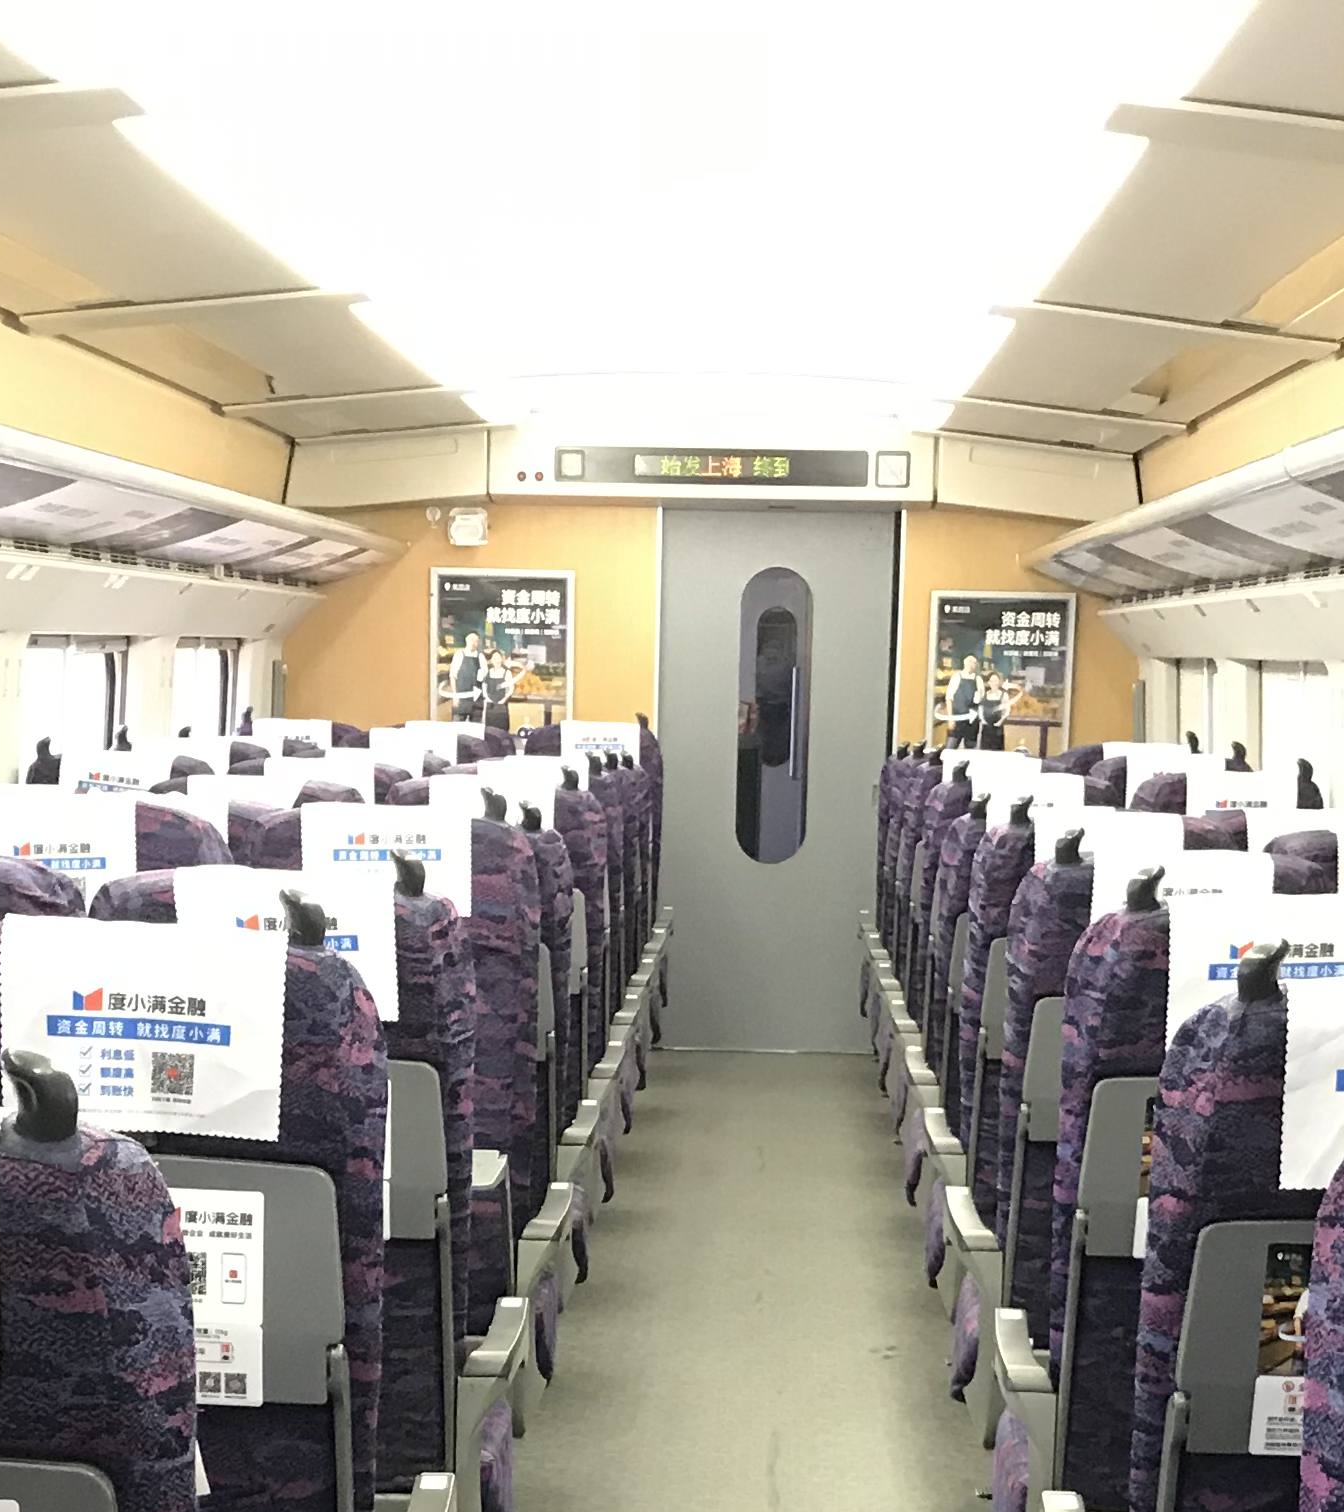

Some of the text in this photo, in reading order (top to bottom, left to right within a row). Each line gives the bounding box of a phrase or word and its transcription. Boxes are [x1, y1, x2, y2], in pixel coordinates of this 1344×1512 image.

[502, 589, 561, 606] 资金周转
[486, 606, 561, 625] 就找度小满
[1001, 611, 1061, 628] 资金周转
[985, 629, 1060, 646] 就找度小满
[108, 993, 206, 1017] 度小满金融
[57, 1019, 221, 1043] 资金周转 就找度小满
[185, 1210, 253, 1226] 度小满金融
